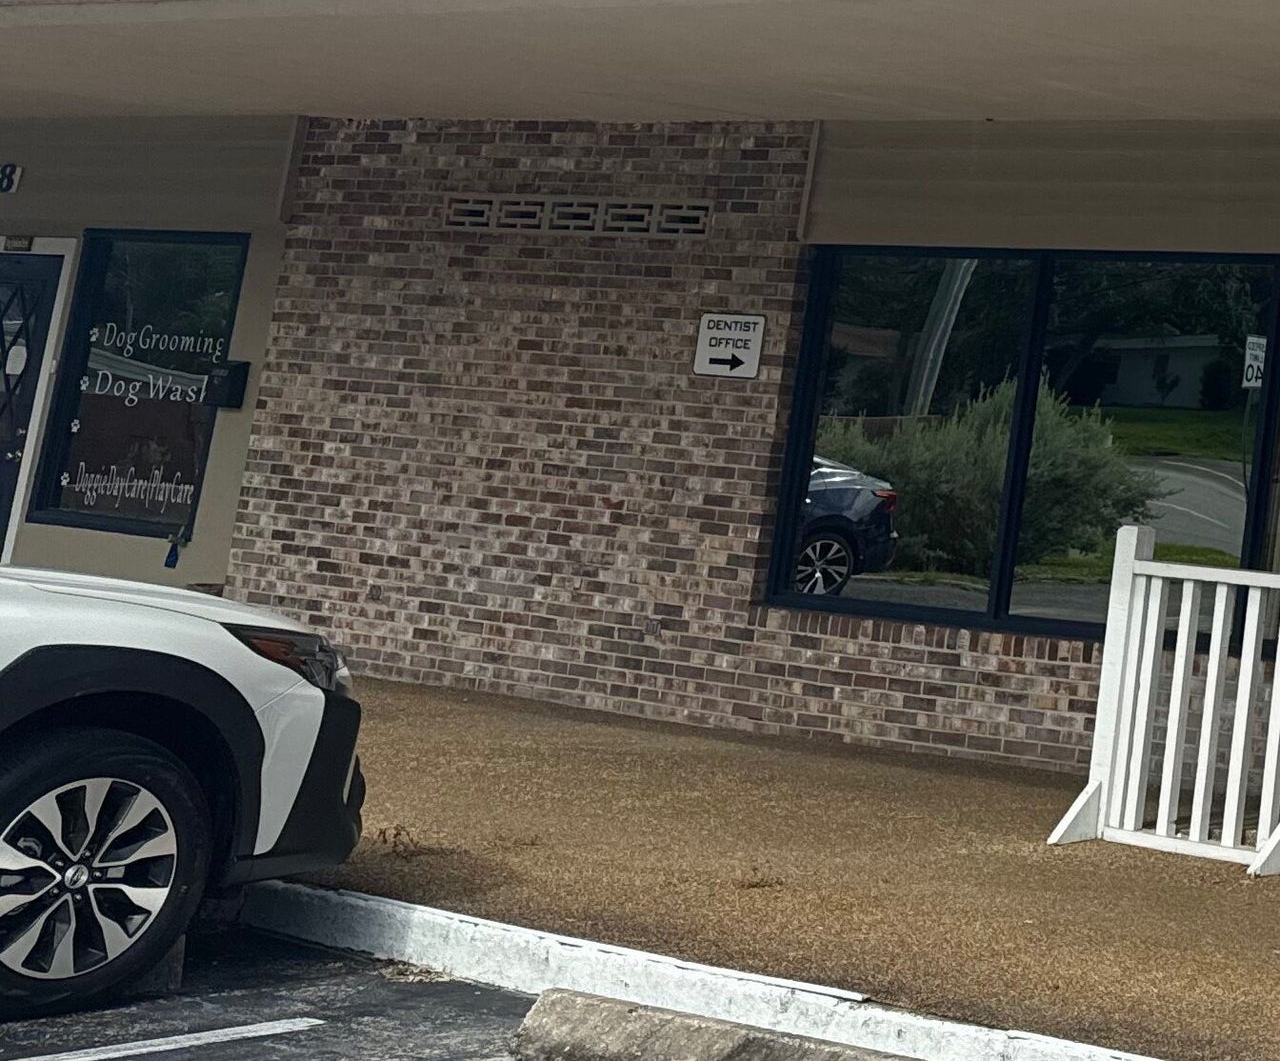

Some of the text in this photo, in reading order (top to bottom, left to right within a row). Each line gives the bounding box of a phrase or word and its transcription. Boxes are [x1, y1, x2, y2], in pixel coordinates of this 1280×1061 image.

[707, 319, 759, 333] DENTIST
[103, 322, 137, 357] Dog
[708, 336, 752, 350] OFFICE
[94, 370, 142, 407] Dog
